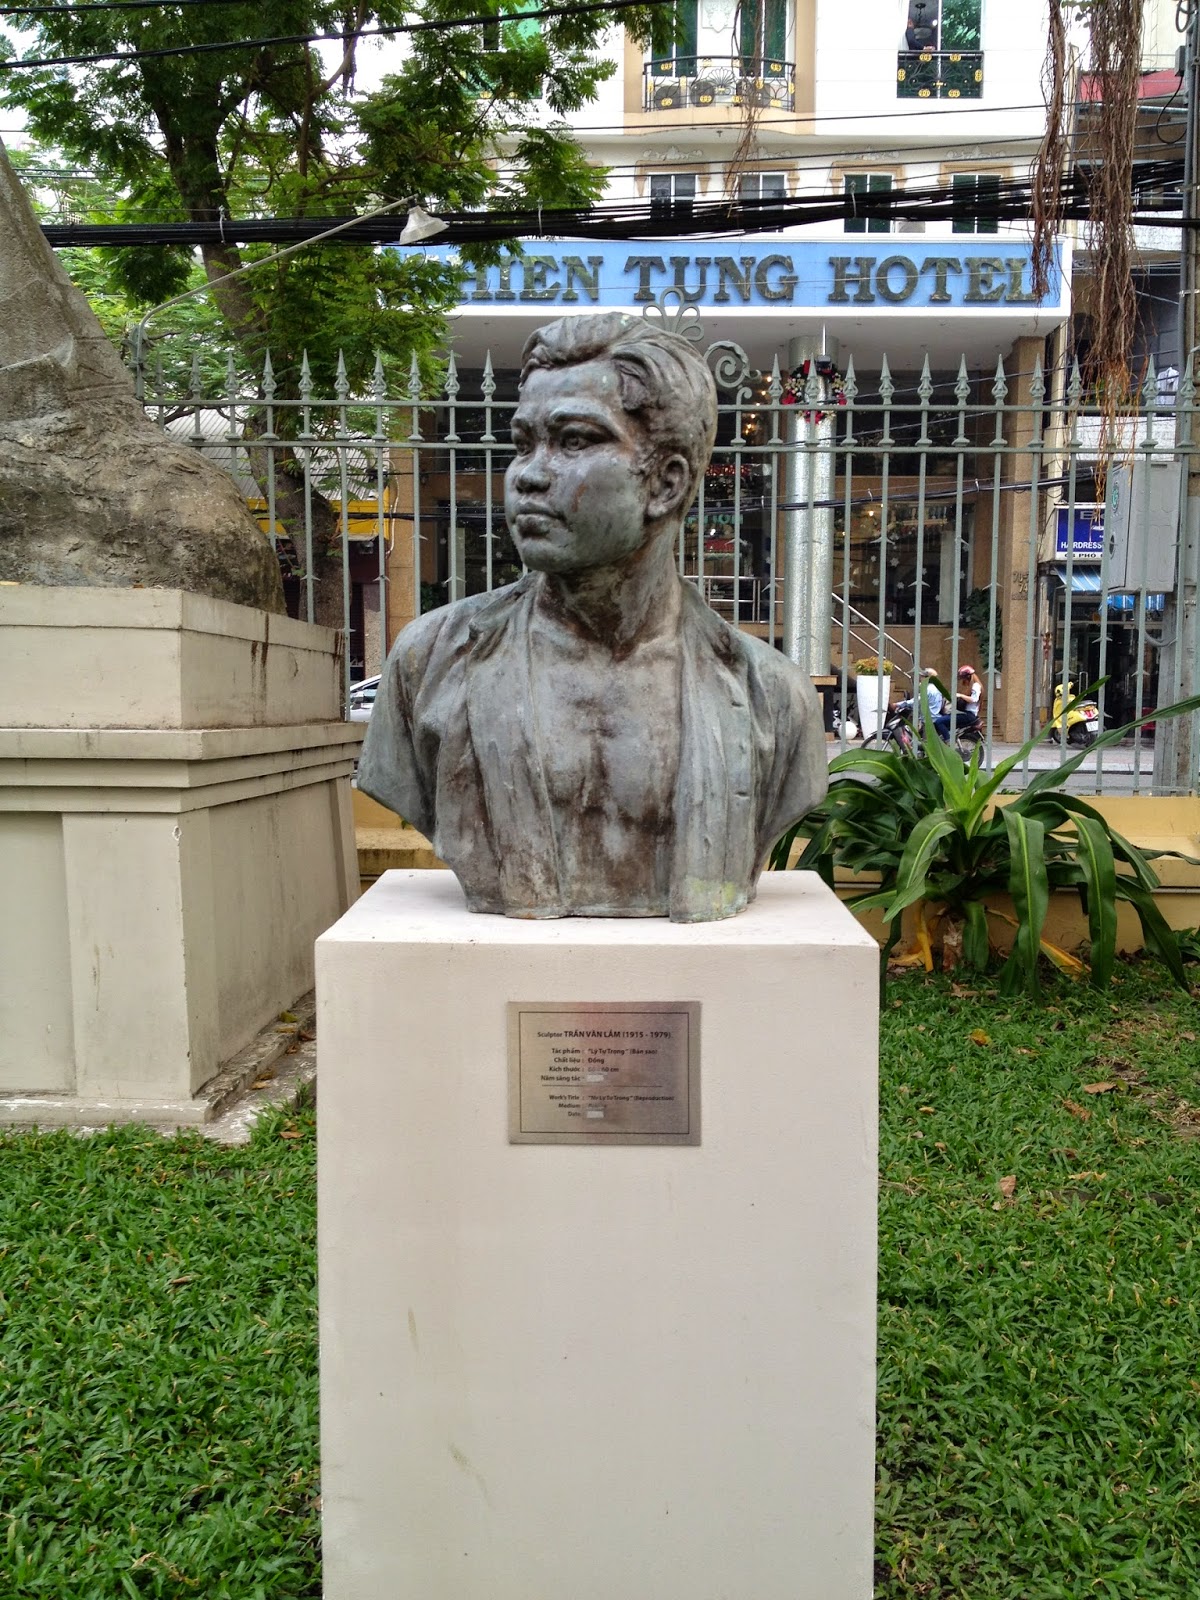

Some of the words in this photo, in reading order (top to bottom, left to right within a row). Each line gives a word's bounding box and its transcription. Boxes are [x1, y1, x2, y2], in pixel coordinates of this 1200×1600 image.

[624, 255, 798, 301] TUNG
[828, 255, 1038, 302] HOTEL
[537, 1031, 563, 1039] Sculptor
[622, 1030, 644, 1039] (1915
